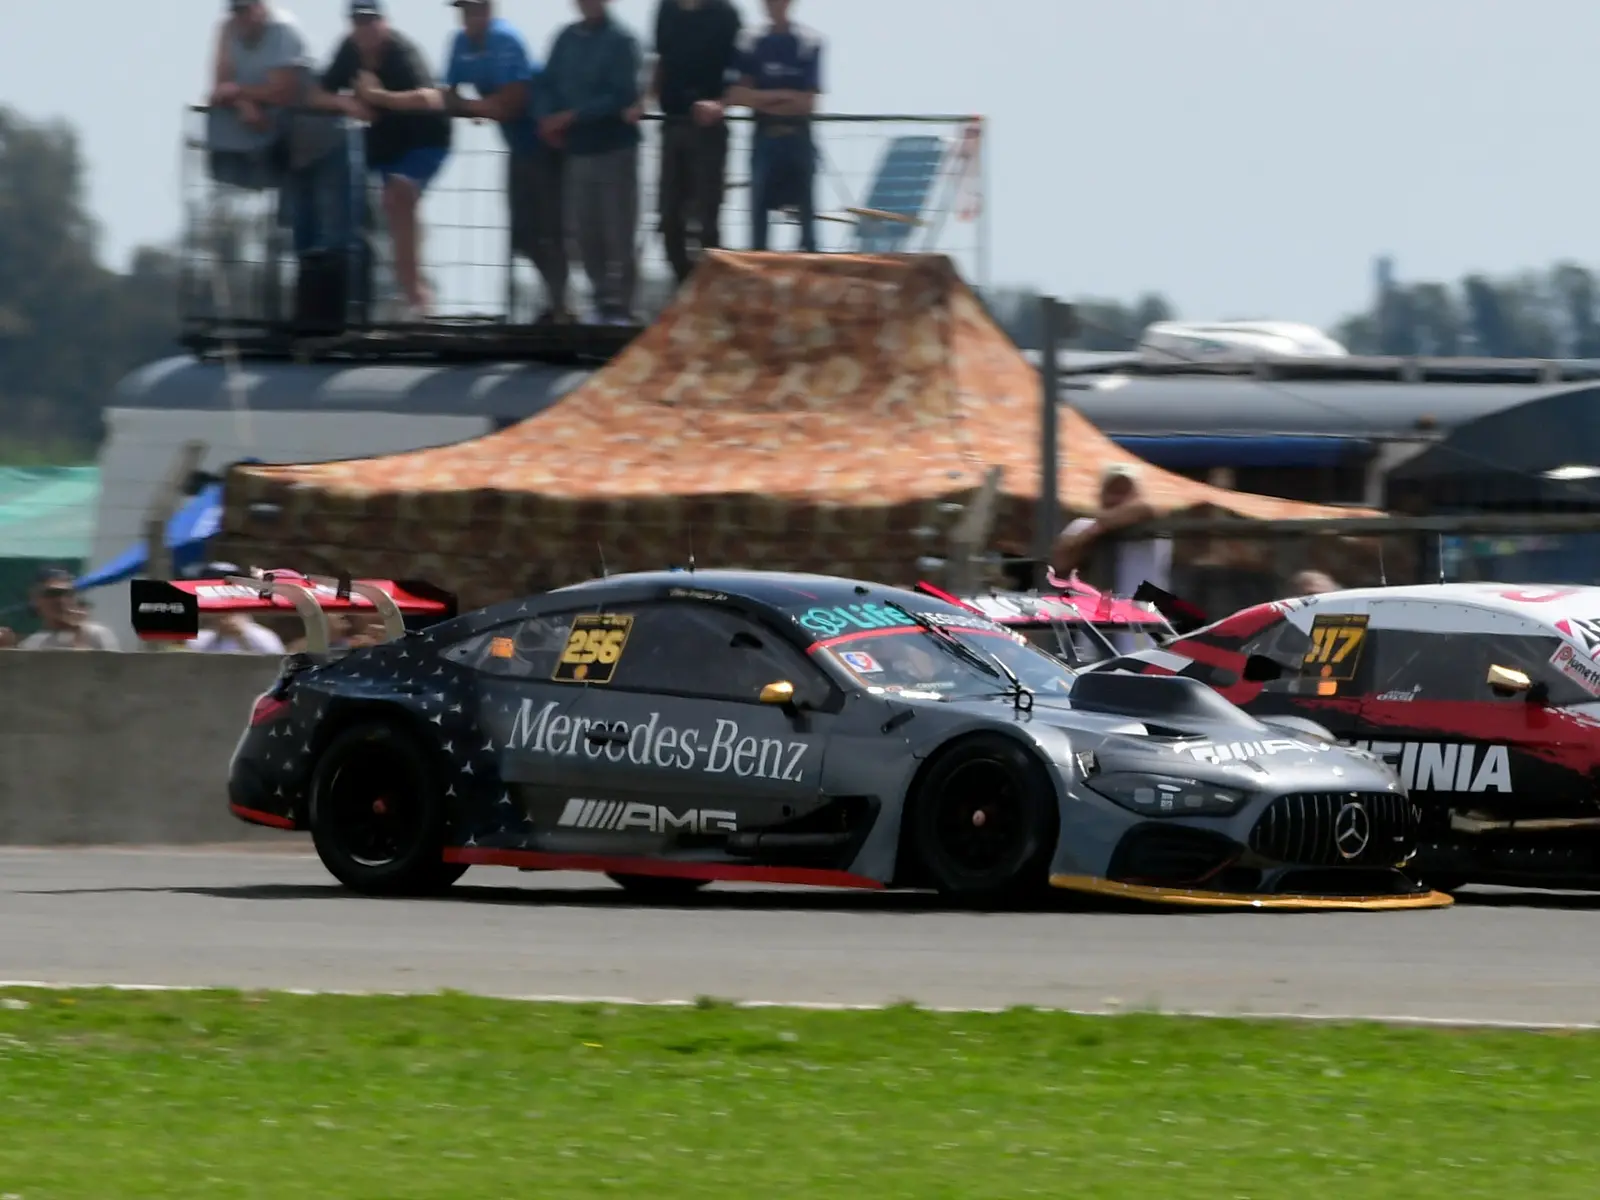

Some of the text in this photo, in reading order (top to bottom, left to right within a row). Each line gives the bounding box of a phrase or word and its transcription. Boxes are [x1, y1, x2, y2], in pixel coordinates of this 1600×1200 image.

[562, 629, 626, 664] 256
[504, 697, 809, 783] Mercedes-Benz
[614, 800, 738, 834] AMG
